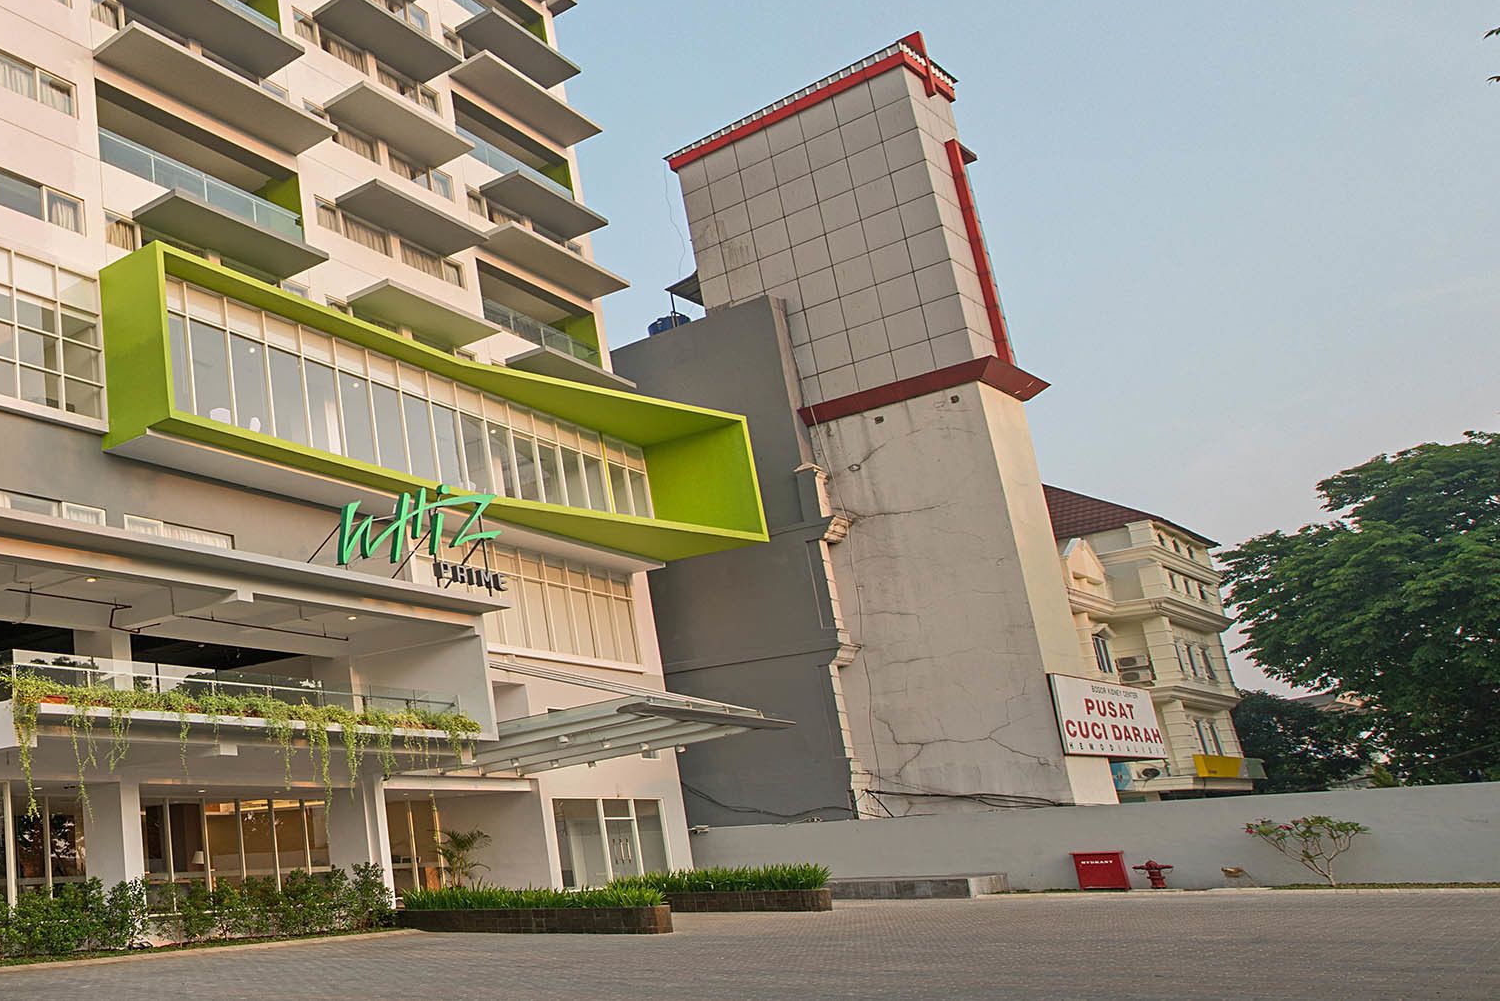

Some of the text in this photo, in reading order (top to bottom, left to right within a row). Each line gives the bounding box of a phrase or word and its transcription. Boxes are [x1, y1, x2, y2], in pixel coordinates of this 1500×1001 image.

[433, 561, 509, 592] PRIME
[1084, 698, 1134, 720] PUSAT
[1065, 719, 1163, 744] CUCI DARAH
